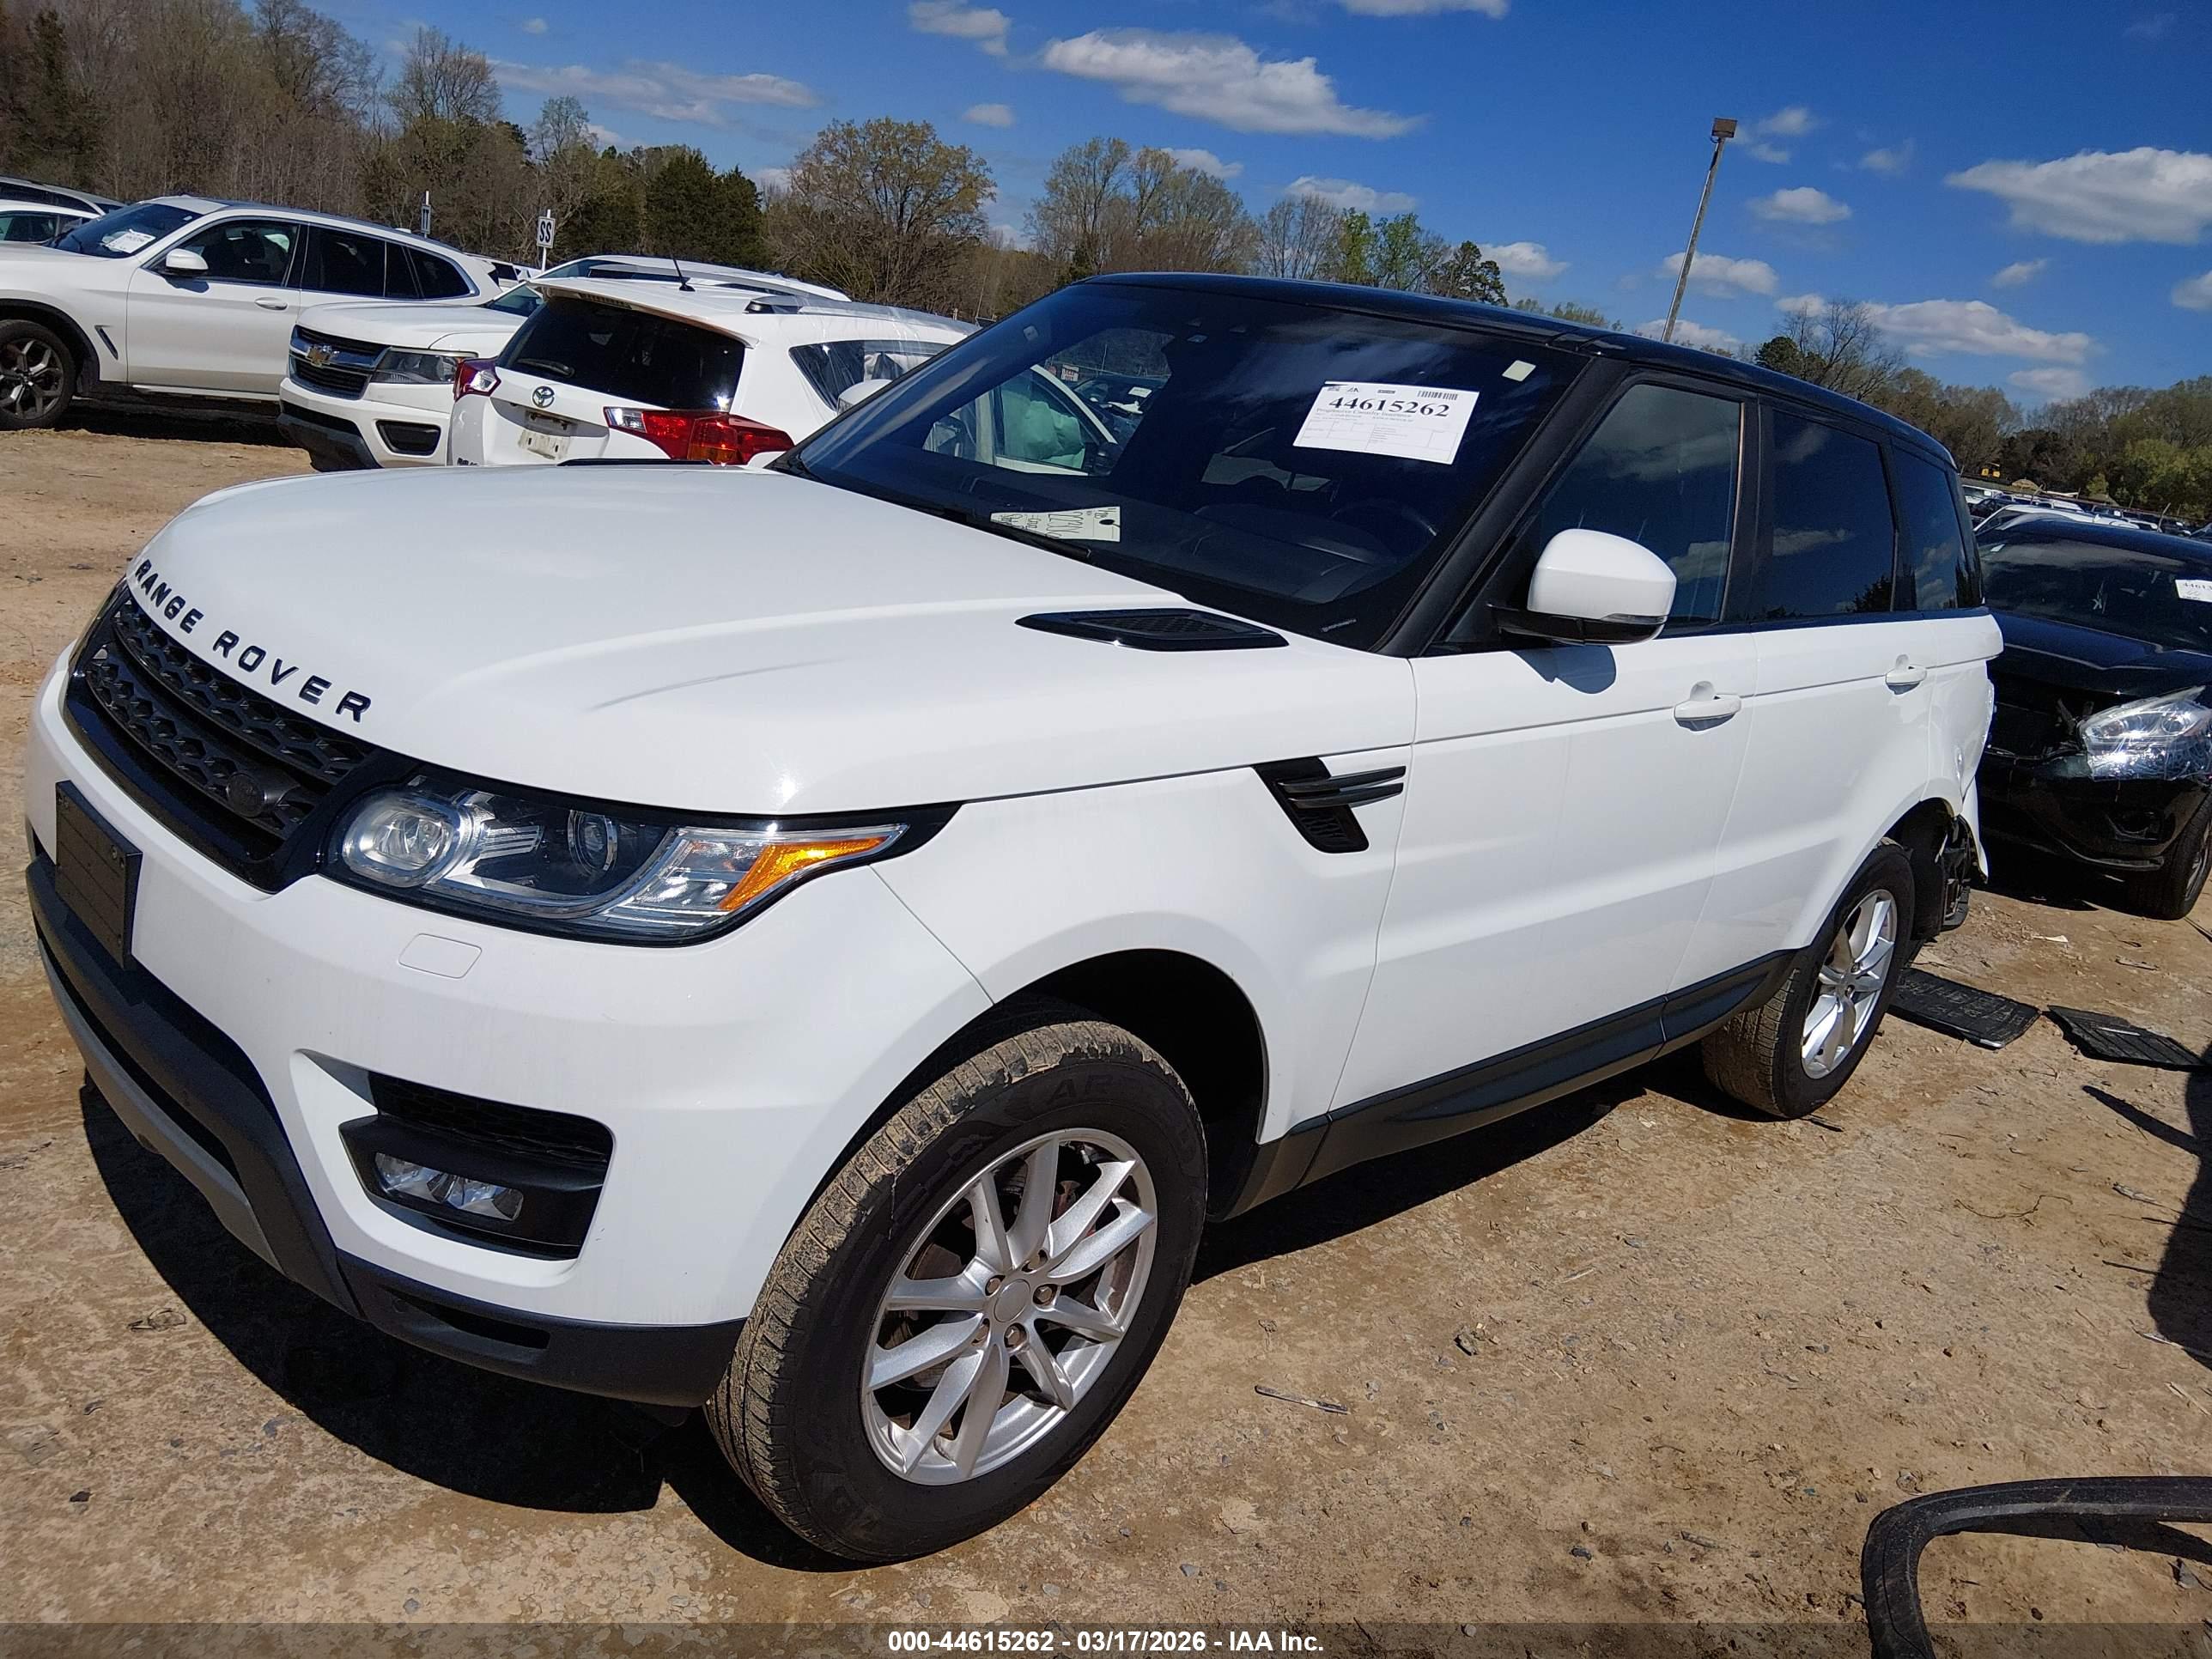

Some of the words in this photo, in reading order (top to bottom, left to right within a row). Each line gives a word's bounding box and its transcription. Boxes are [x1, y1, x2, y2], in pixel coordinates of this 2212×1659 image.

[539, 220, 552, 243] SS
[1328, 396, 1449, 417] 44615262
[135, 558, 204, 635] RANGE
[212, 629, 372, 723] ROVER
